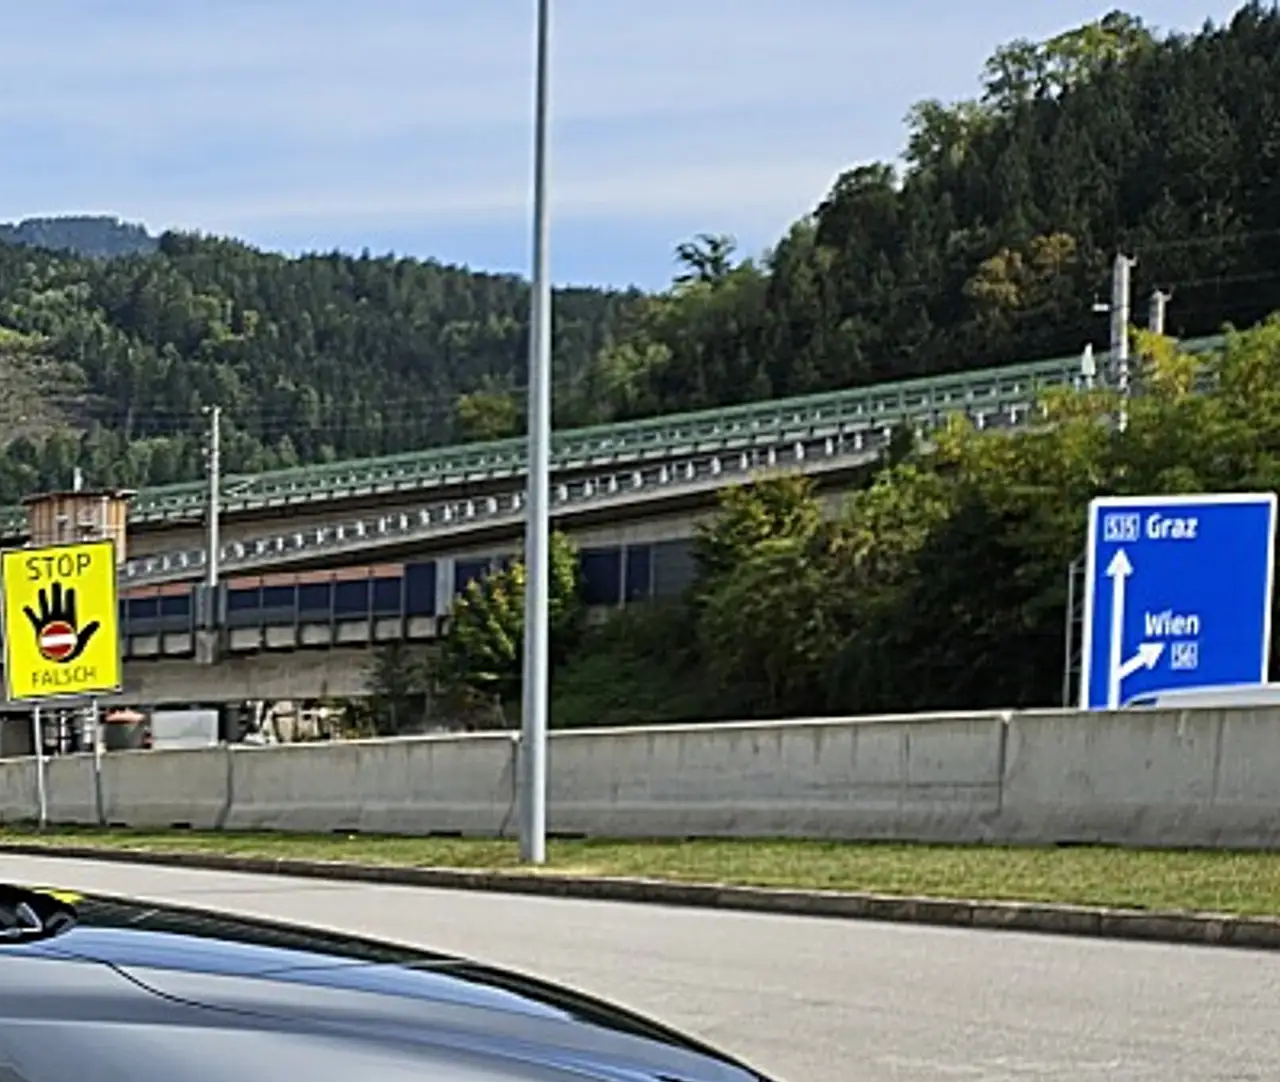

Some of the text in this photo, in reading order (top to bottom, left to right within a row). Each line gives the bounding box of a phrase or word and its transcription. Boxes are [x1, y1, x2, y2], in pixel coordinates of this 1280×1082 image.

[1145, 513, 1199, 539] Graz
[25, 553, 91, 581] STOP
[1145, 608, 1200, 637] Wien
[31, 665, 98, 688] FALSCH
